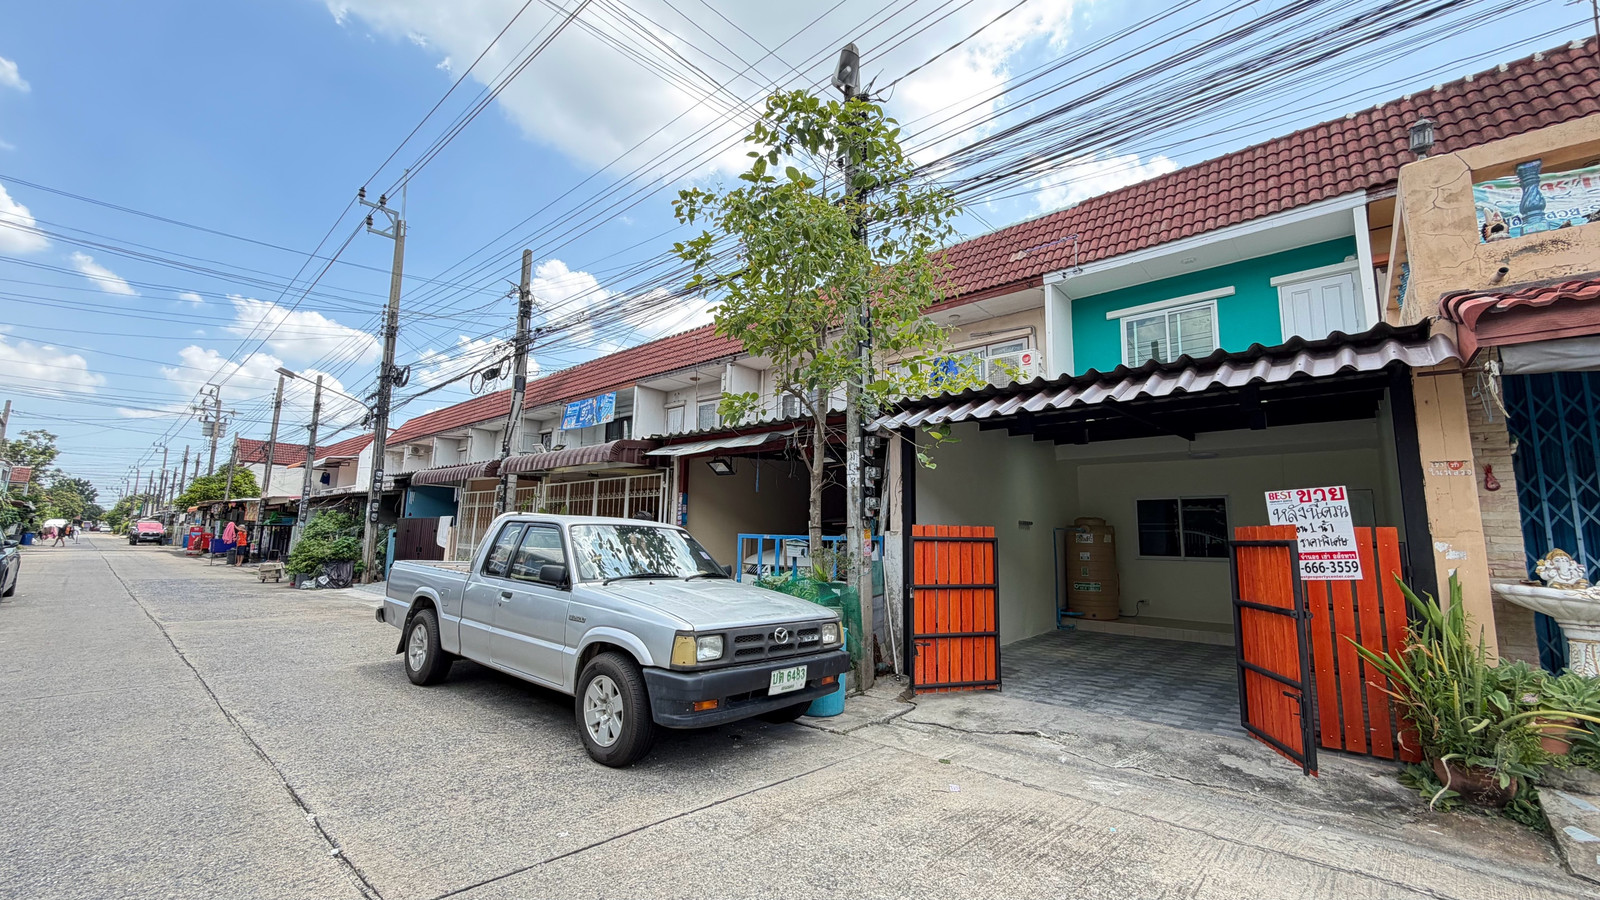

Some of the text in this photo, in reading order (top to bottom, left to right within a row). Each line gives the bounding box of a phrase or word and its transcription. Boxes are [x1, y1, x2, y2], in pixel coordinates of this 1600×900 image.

[1268, 491, 1291, 501] BEST
[1296, 486, 1345, 503] ขาย
[1272, 498, 1349, 523] หลังนี้ด่วน
[1309, 522, 1317, 533] 1
[1300, 534, 1349, 548] ราคาพิเศษ
[1300, 560, 1359, 574] -666-3559
